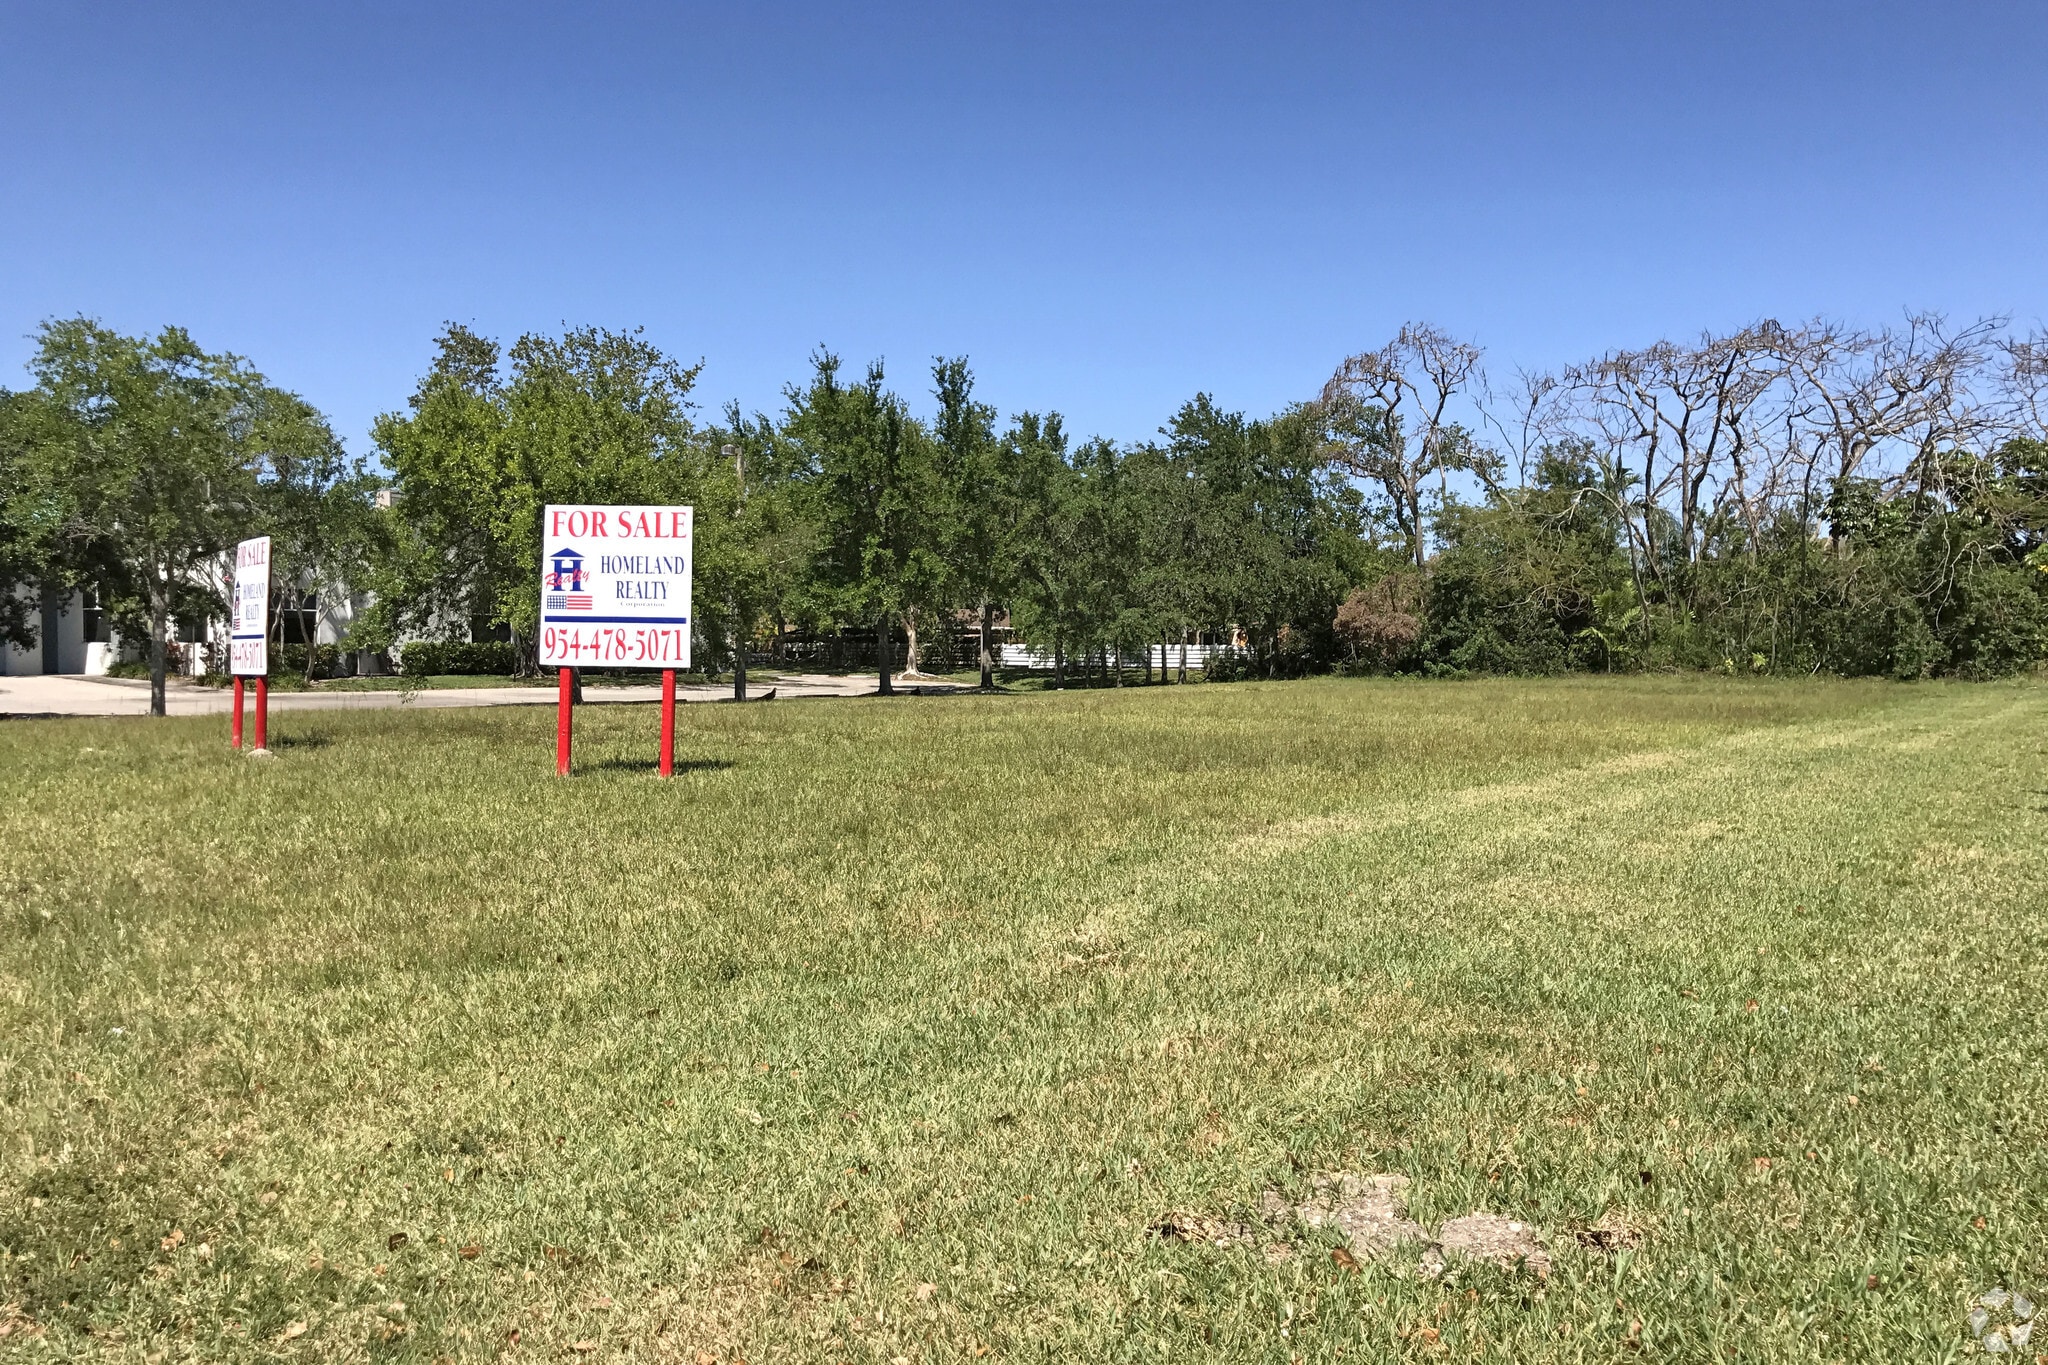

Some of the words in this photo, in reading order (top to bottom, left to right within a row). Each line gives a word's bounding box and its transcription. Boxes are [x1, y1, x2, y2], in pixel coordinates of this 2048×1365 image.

[552, 510, 608, 537] FOR
[617, 510, 687, 538] SALE
[248, 541, 266, 567] SALE
[601, 555, 685, 575] HOMELAND
[544, 568, 590, 589] Realty
[616, 580, 669, 600] REALTY
[544, 627, 683, 661] 954-478-5071
